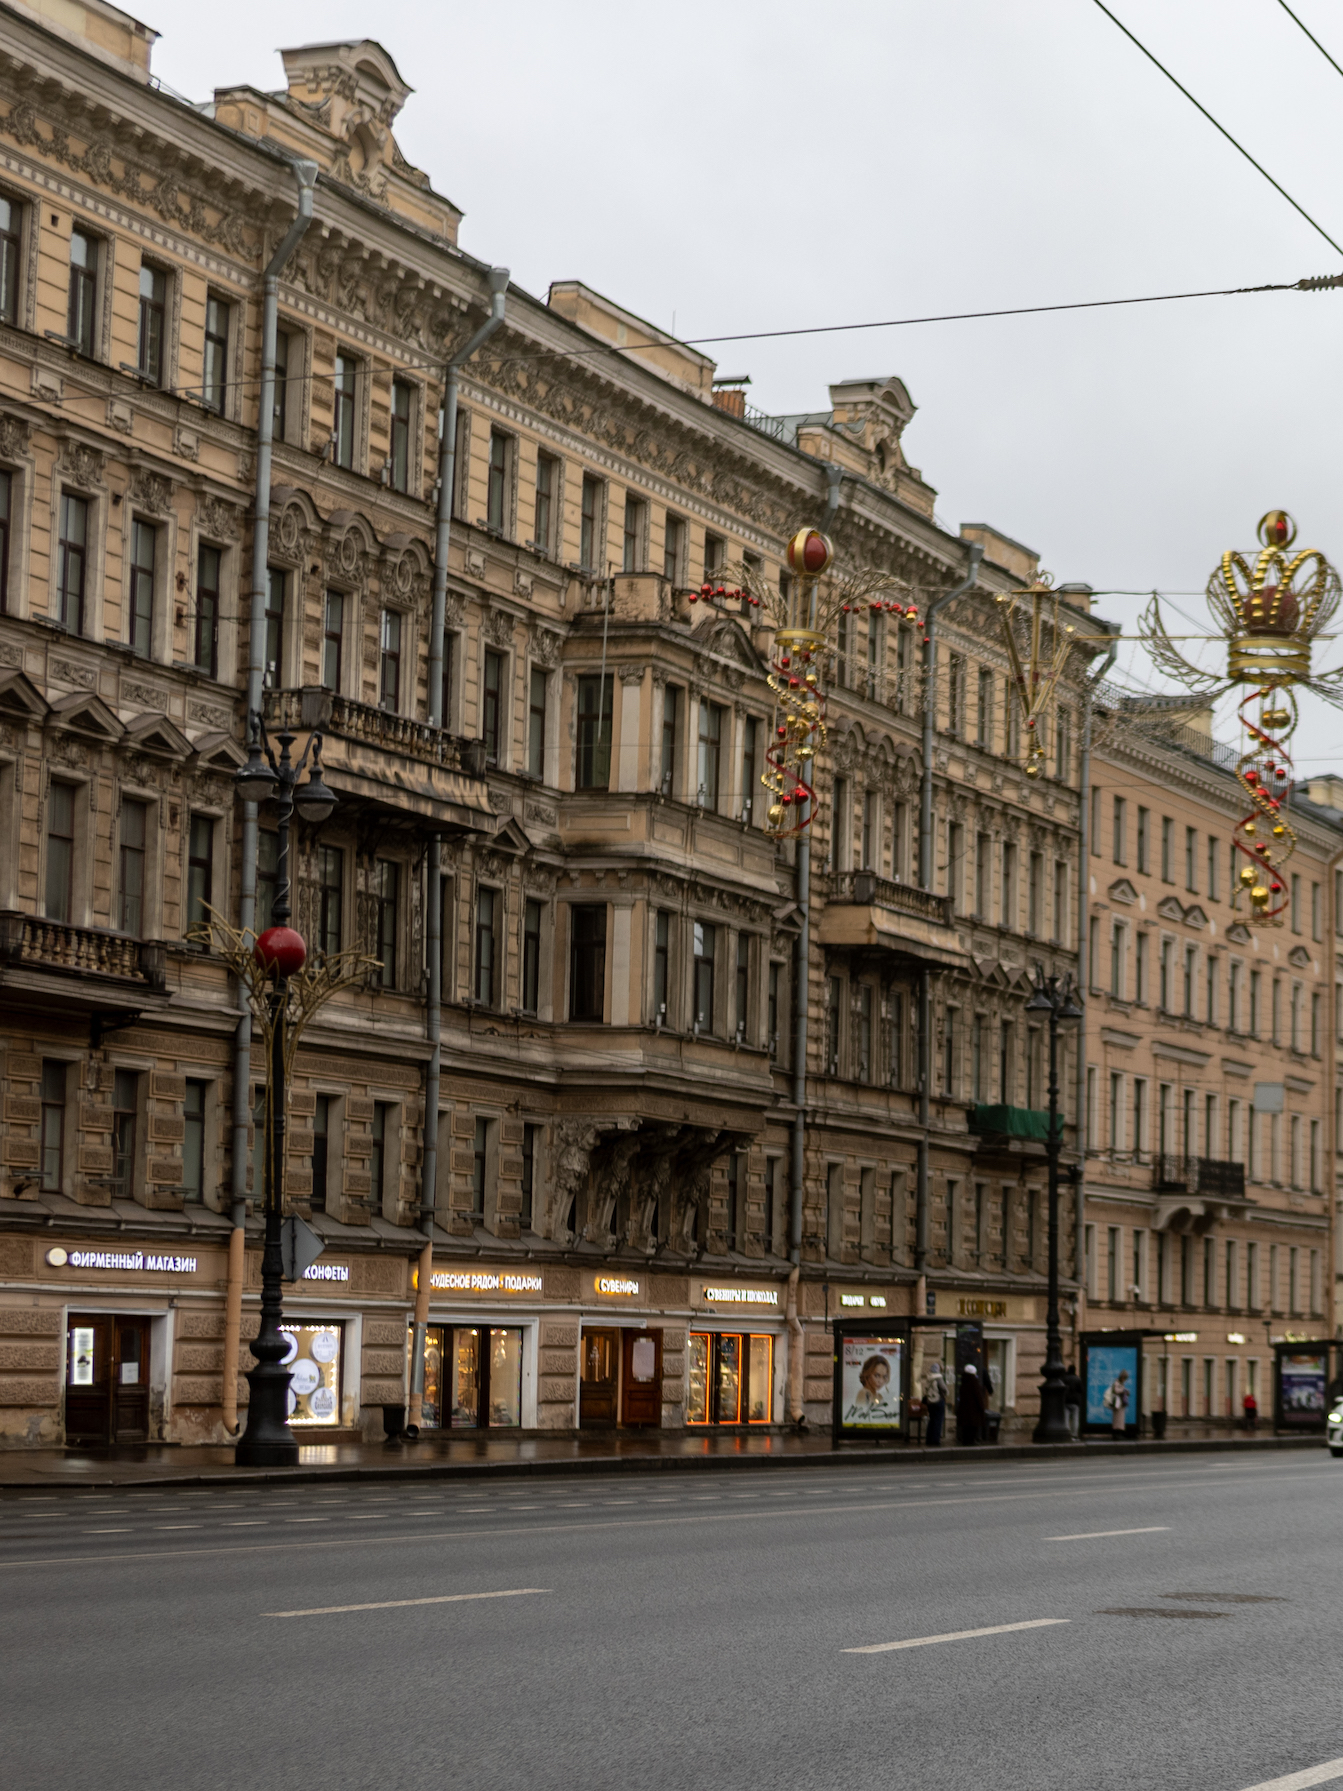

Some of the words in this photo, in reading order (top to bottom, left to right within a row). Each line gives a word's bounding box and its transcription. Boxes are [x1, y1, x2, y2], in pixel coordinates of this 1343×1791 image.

[71, 1251, 143, 1270] ФИРМЕННЫЙ
[146, 1255, 197, 1272] МАГАЗИН
[303, 1264, 349, 1281] КОНФЕТЫ
[430, 1273, 470, 1288] ЧУДЕСНОЕ
[471, 1275, 499, 1290] РЯДОМ
[505, 1276, 542, 1291] ПОДАРКИ
[600, 1278, 639, 1295] СУВЕНИРЫ
[706, 1287, 740, 1302] СУВЕНИРЫ
